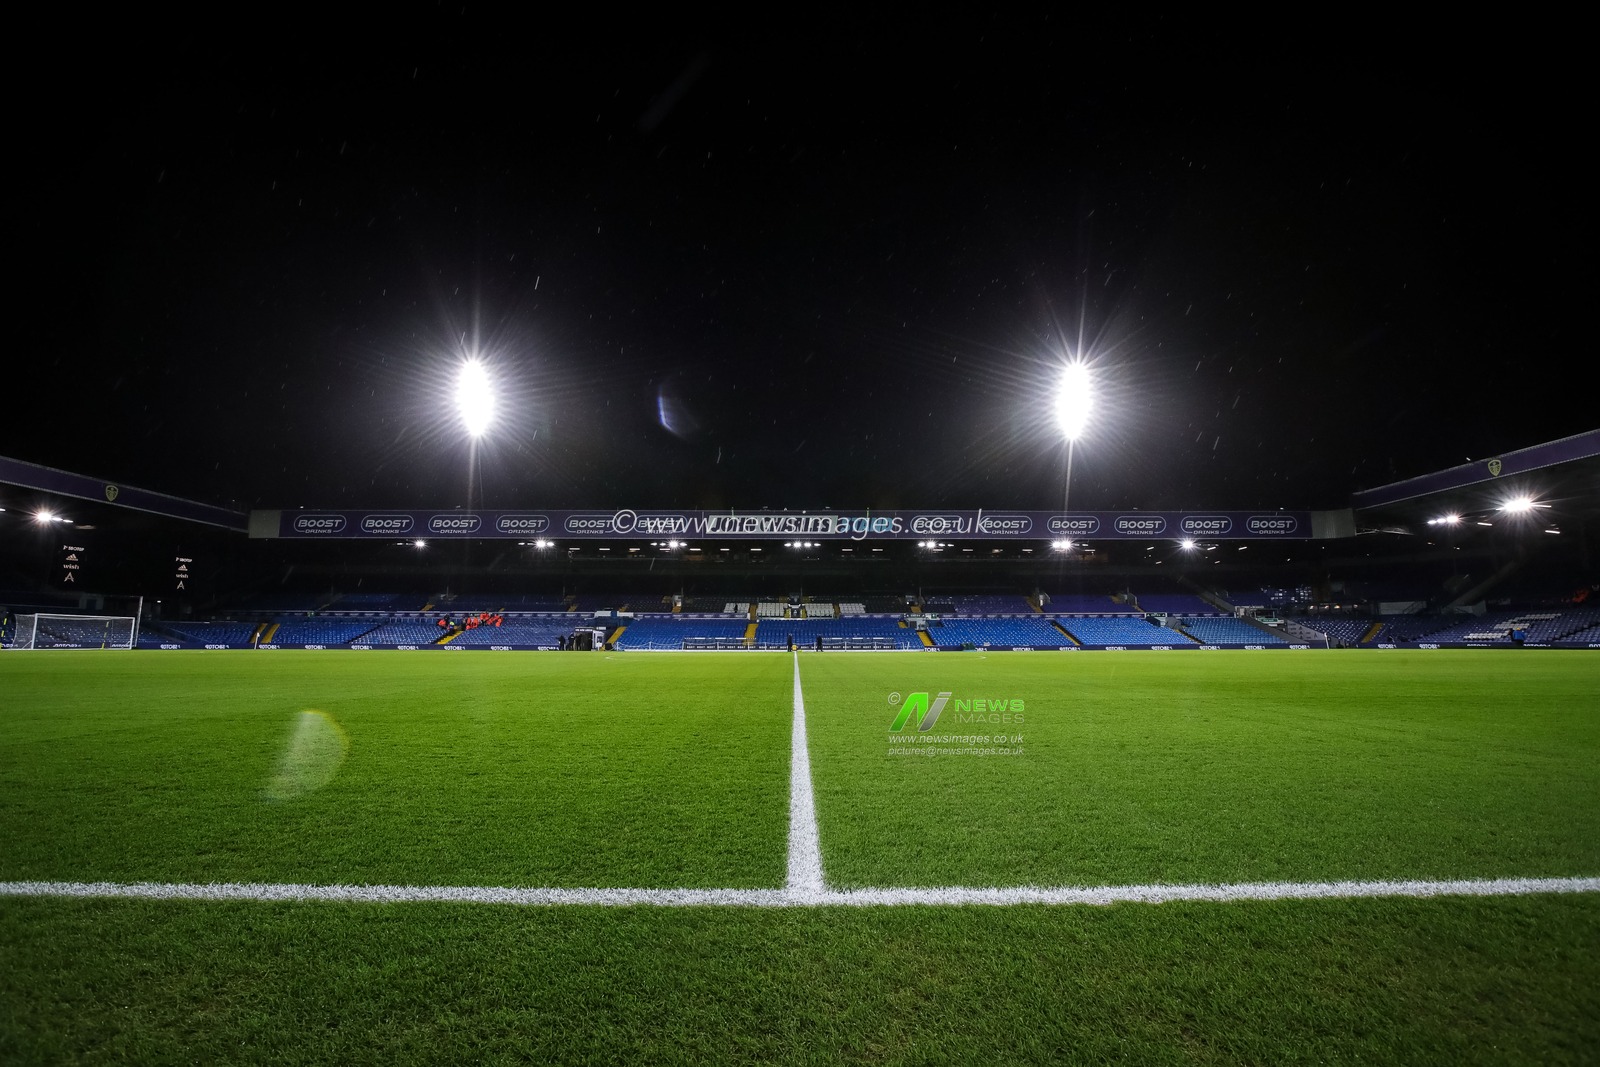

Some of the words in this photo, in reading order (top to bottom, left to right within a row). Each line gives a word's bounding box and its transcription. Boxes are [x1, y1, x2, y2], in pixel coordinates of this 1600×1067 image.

[298, 519, 342, 528] BOOST
[365, 519, 410, 528] BOOST
[432, 519, 477, 528] BOOST
[500, 519, 545, 528] BOOST
[569, 519, 614, 528] BOOST
[983, 520, 1028, 529] BOOST
[1051, 520, 1096, 529] BOOST
[1119, 520, 1162, 529] BOOST
[1185, 520, 1228, 529] BOOST
[1250, 520, 1293, 529] BOOST
